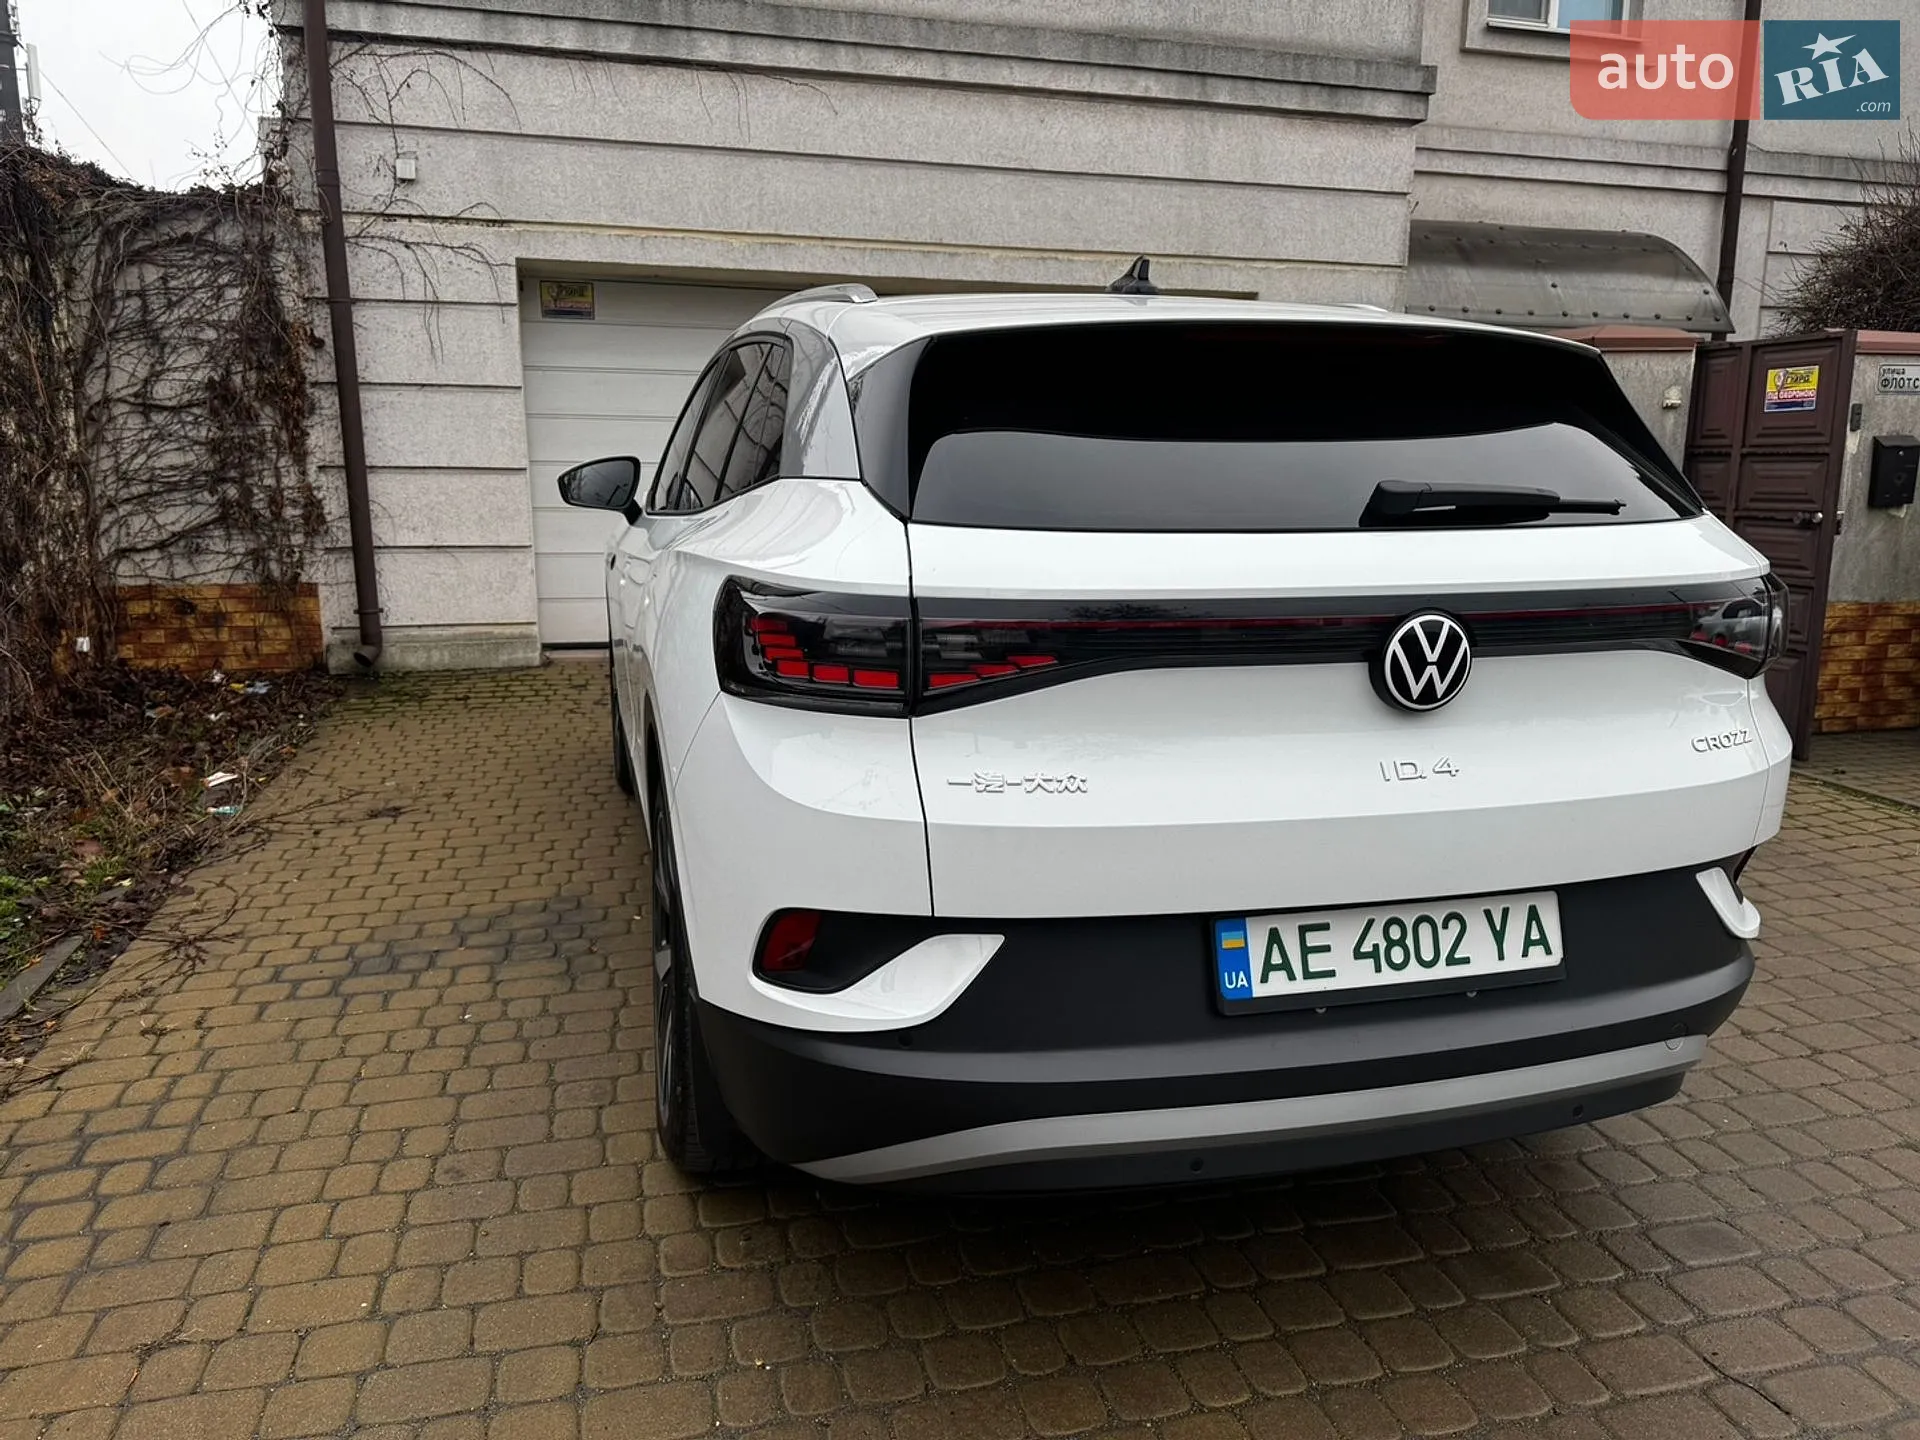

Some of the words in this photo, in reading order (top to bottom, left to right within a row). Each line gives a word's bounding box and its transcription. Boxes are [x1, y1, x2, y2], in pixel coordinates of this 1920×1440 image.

[1384, 614, 1471, 711] VW
[1690, 728, 1752, 753] CROZZ
[1260, 921, 1337, 984] AE
[1353, 911, 1472, 974] 4802
[1482, 904, 1554, 962] YA
[1224, 971, 1249, 989] UA
